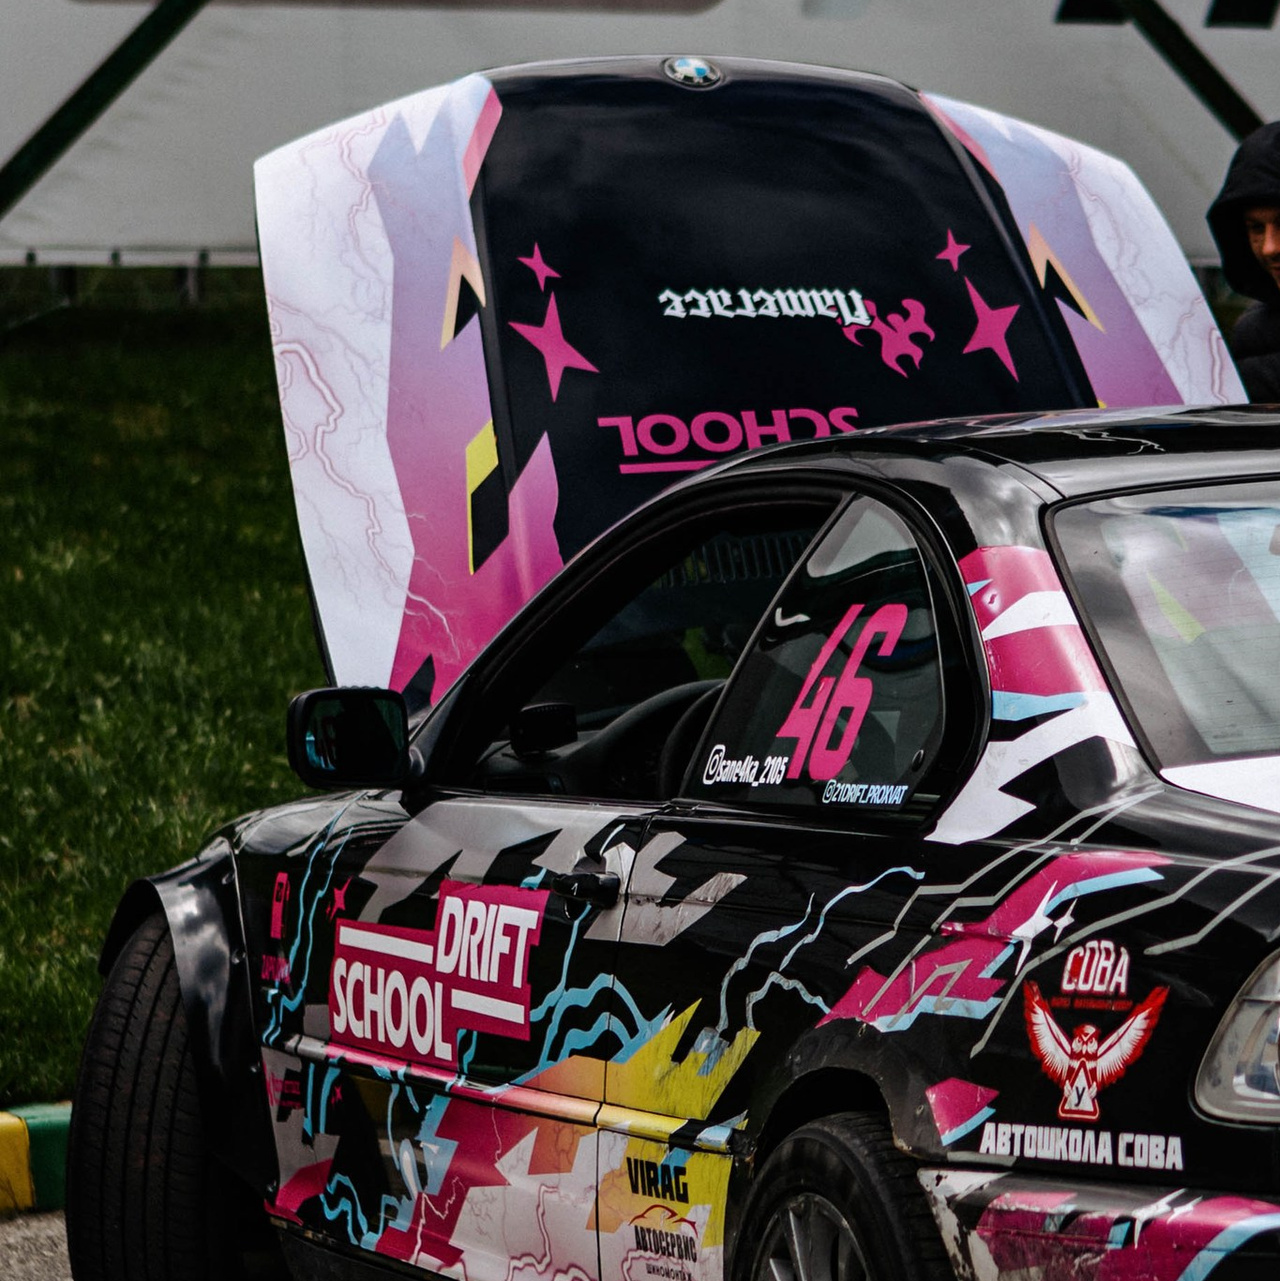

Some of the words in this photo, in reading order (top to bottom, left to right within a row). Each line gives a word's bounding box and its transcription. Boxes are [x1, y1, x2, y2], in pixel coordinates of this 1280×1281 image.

[775, 603, 909, 782] 46
[435, 896, 539, 989] DRIFT
[1060, 939, 1131, 995] СОВА
[332, 958, 454, 1062] SCHOOL
[979, 1121, 1113, 1165] АВТОШКОЛА
[1117, 1133, 1184, 1171] СОВА
[626, 1157, 689, 1204] VIRAG
[634, 1225, 697, 1263] АВТОСЕРВИС
